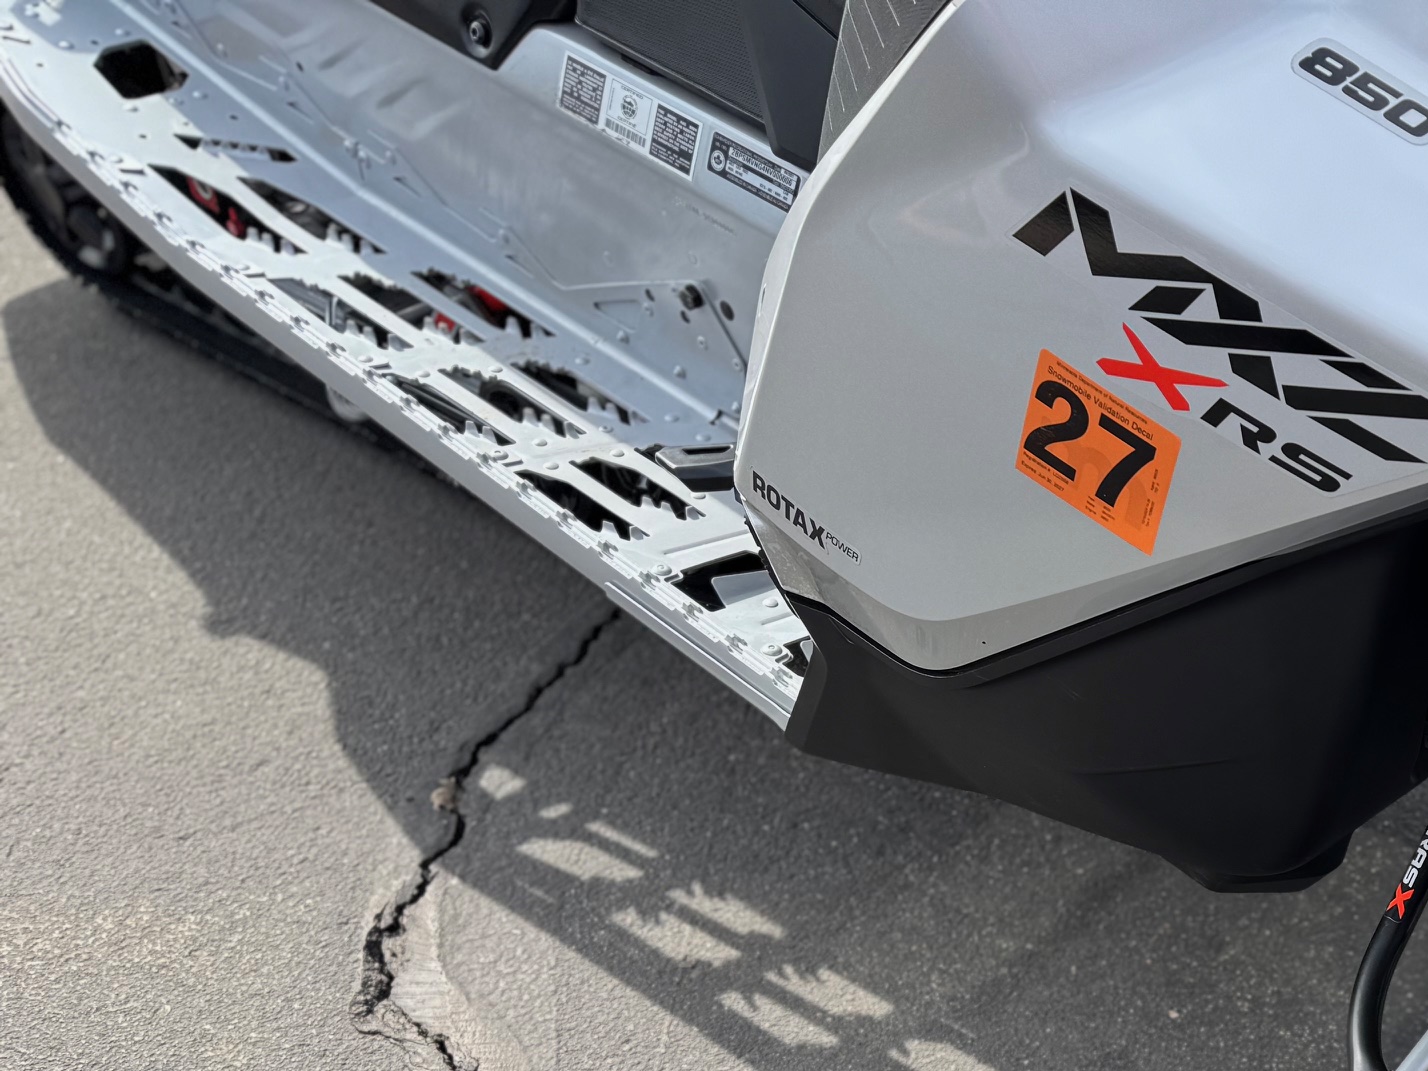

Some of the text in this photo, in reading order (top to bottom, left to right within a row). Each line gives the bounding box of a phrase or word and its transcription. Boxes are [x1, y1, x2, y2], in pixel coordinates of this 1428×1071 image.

[1024, 380, 1157, 507] 27
[1047, 366, 1153, 440] Snowmobile Validation Decal
[753, 470, 859, 562] ROTAX POWER
